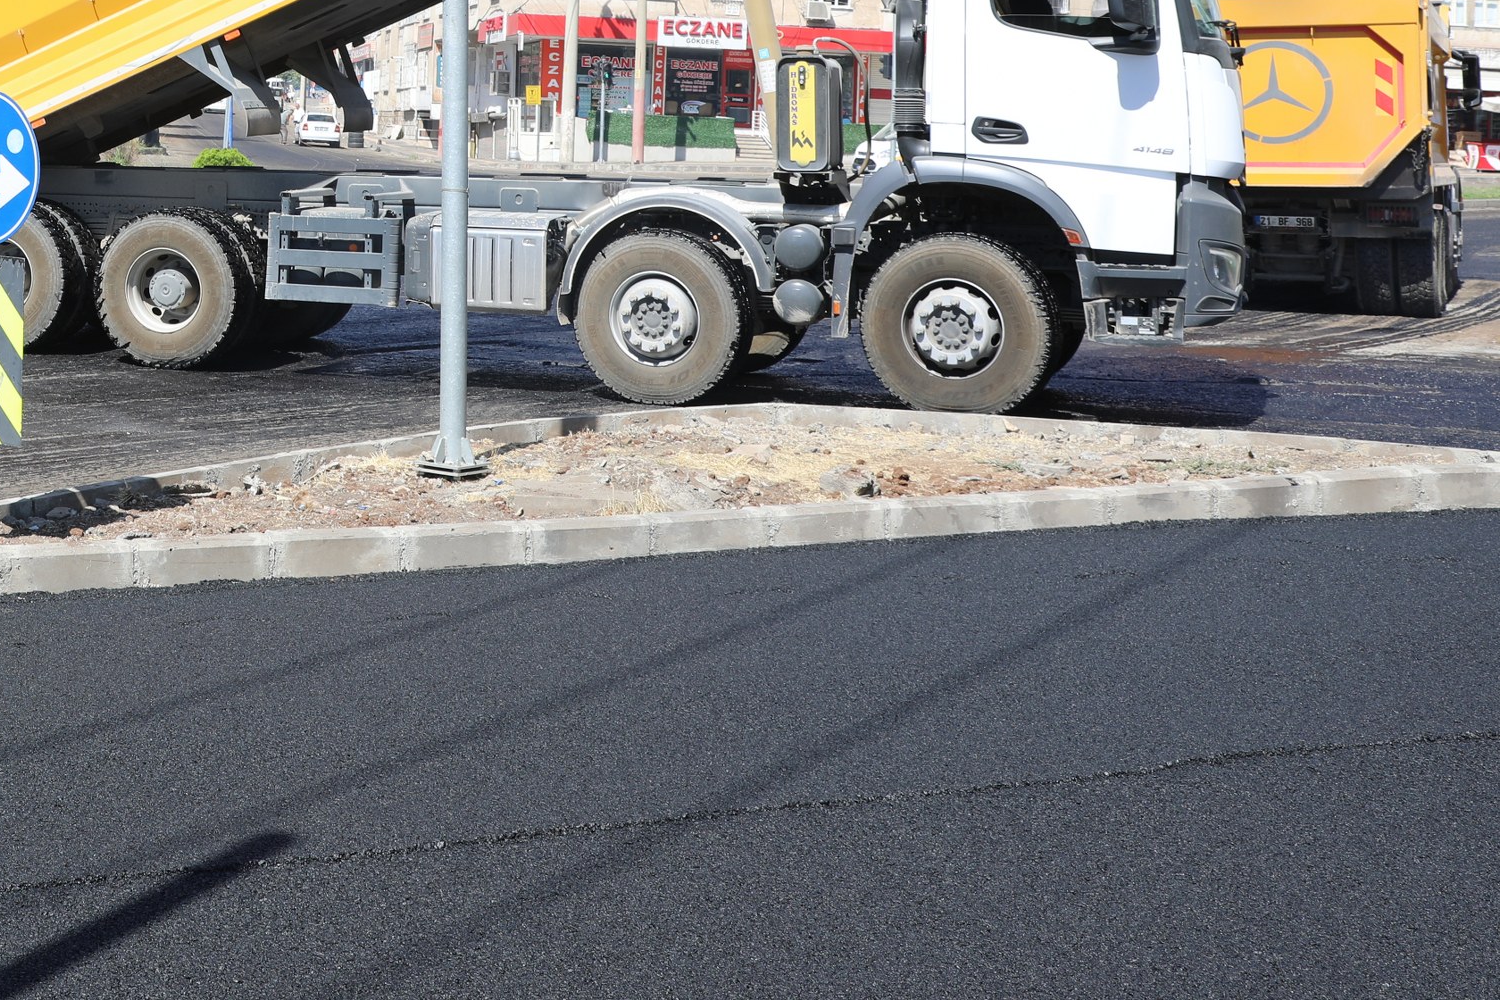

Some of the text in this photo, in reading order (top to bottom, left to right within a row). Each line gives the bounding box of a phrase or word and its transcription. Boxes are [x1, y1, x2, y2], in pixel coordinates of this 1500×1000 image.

[662, 19, 743, 40] ECZANE
[685, 37, 720, 46] GÖKDERE
[670, 59, 719, 72] ECZANE
[790, 71, 799, 126] HİDROMAS
[1132, 146, 1175, 156] 4148
[1259, 216, 1313, 227] 21 BF 968
